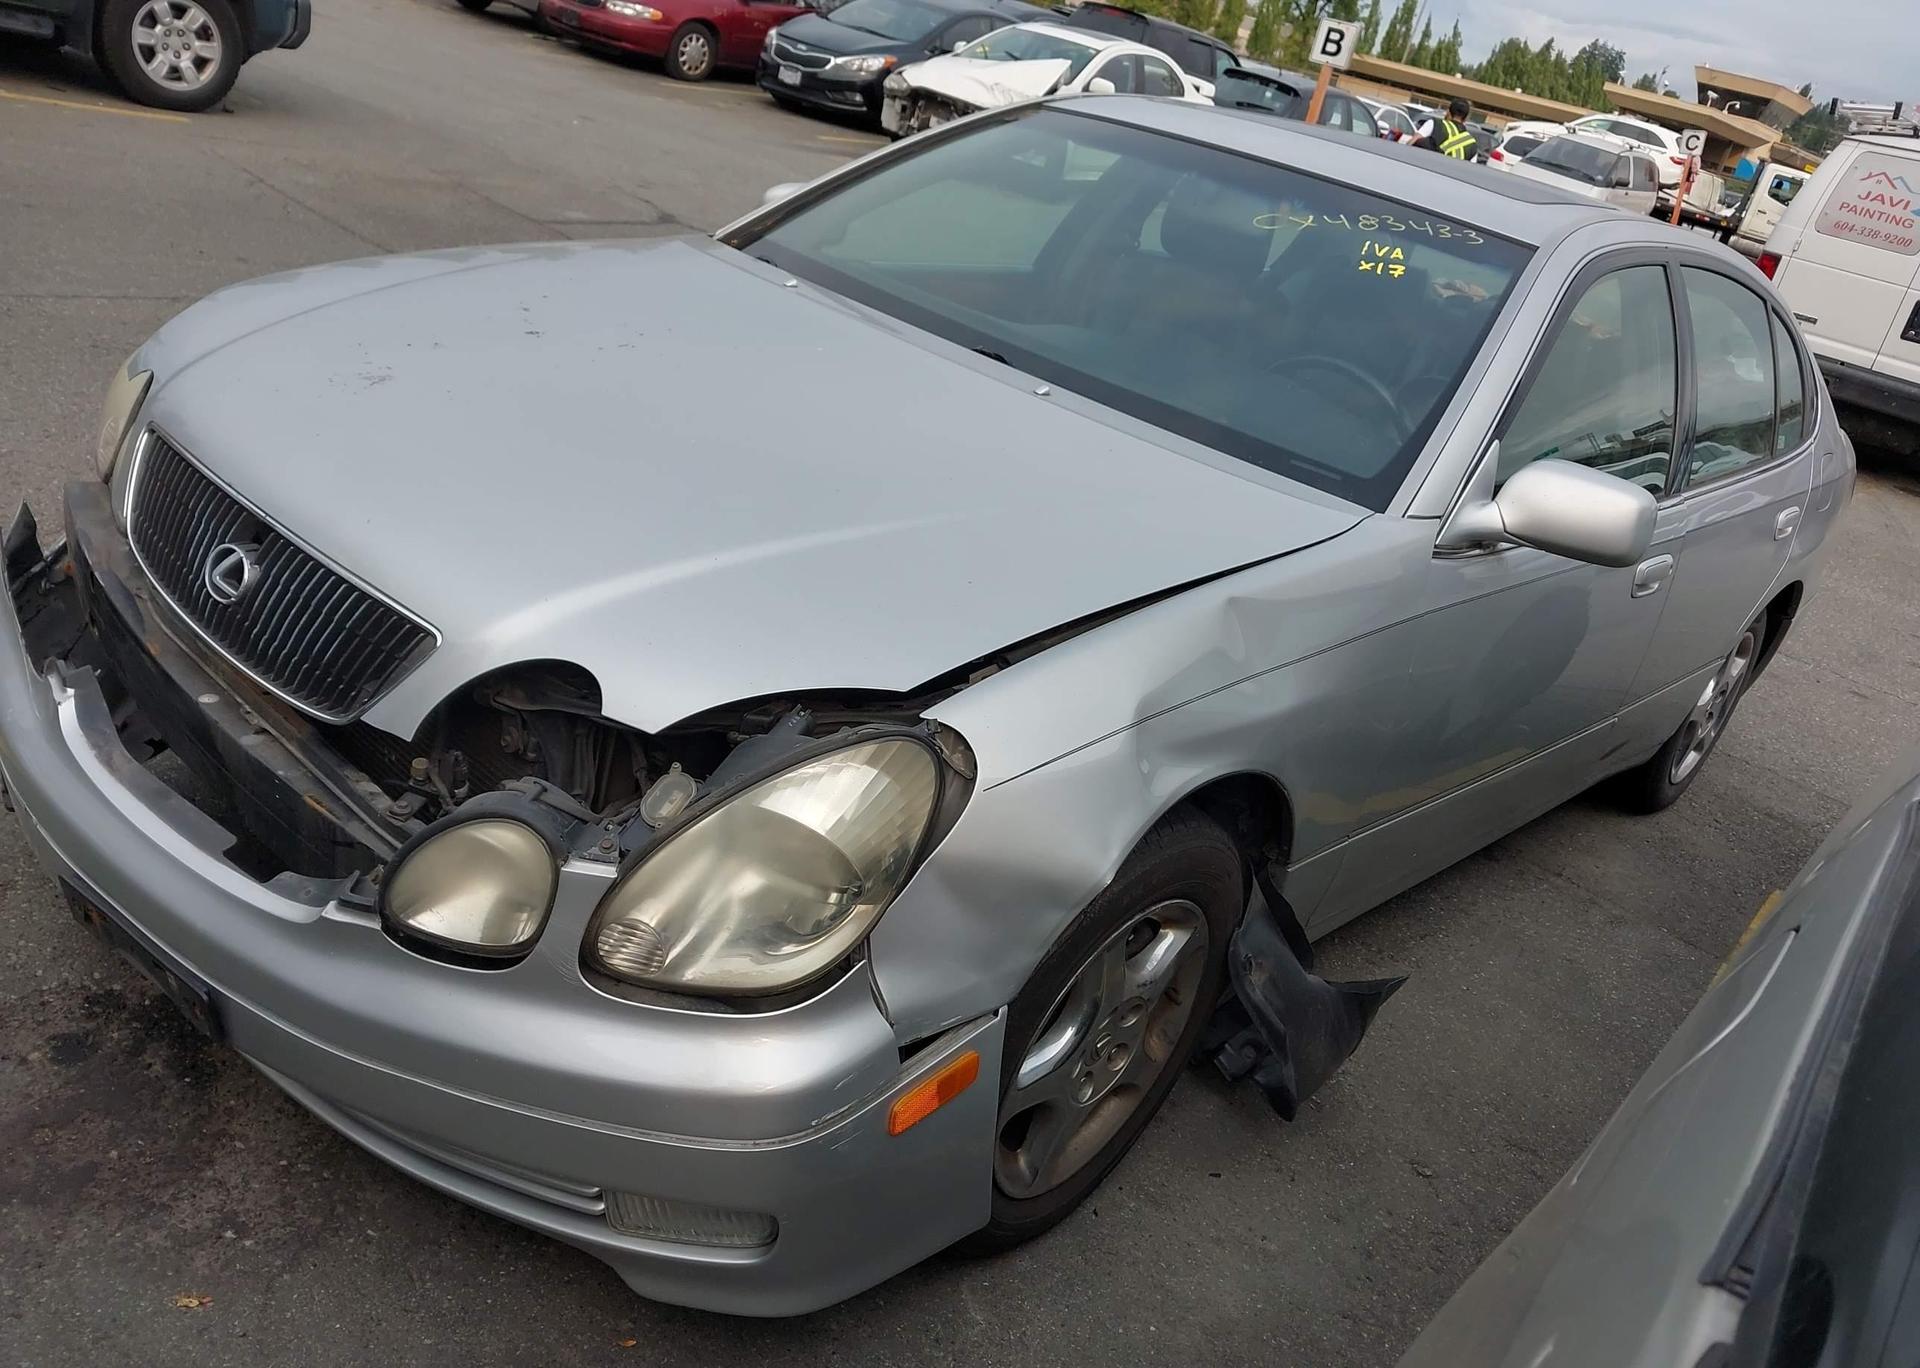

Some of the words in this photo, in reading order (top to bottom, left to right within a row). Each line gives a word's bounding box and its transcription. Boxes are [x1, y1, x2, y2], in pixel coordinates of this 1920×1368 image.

[1321, 27, 1345, 56] B
[1686, 135, 1700, 150] C
[1857, 191, 1911, 210] JAVI
[1839, 202, 1915, 229] PAINTING
[1833, 220, 1913, 248] 604-338-9200
